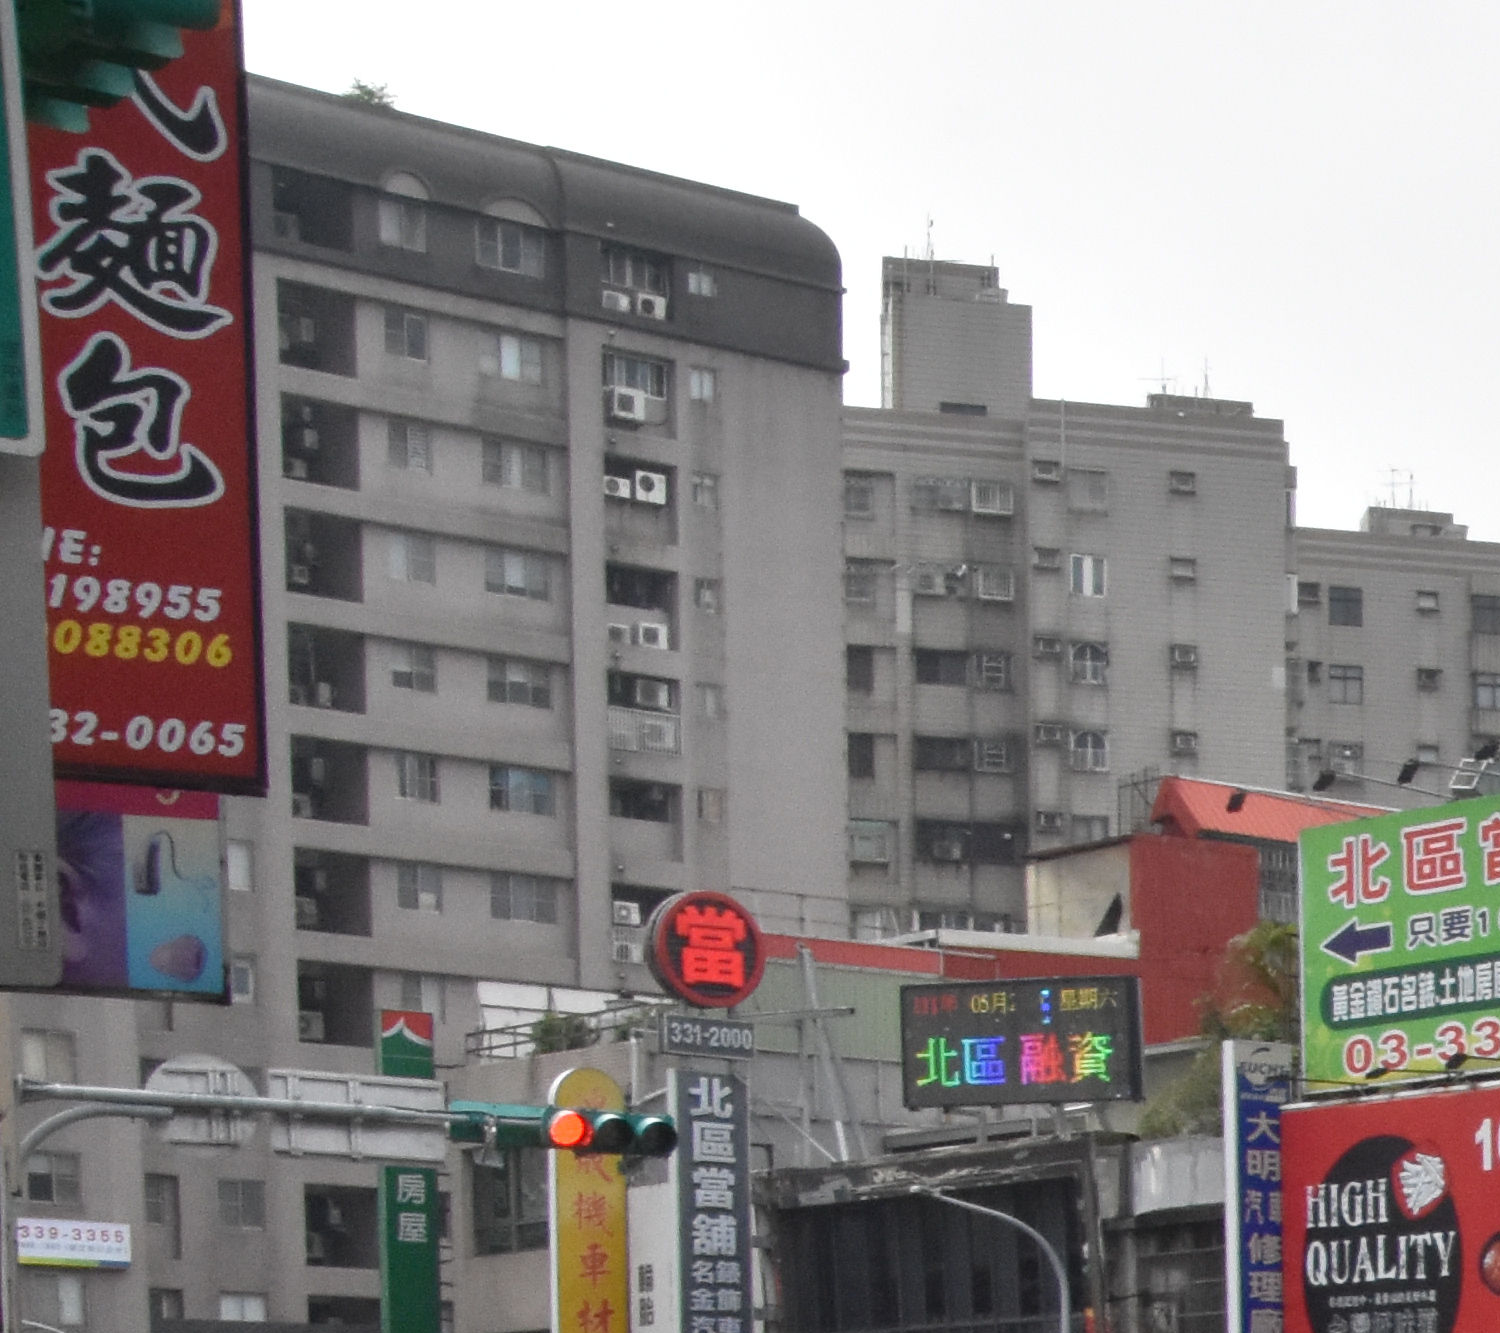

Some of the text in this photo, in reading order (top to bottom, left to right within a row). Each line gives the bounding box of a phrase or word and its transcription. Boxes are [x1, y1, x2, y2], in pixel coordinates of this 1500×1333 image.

[35, 66, 233, 508] 麵包
[675, 904, 747, 989] 當
[670, 1021, 754, 1050] 331-2000
[916, 1031, 1115, 1088] 北區 融資
[689, 1076, 737, 1258] 北區當舖
[396, 1173, 429, 1243] 房屋
[1305, 1176, 1389, 1230] HIGH
[1305, 1230, 1457, 1287] QUALITY
